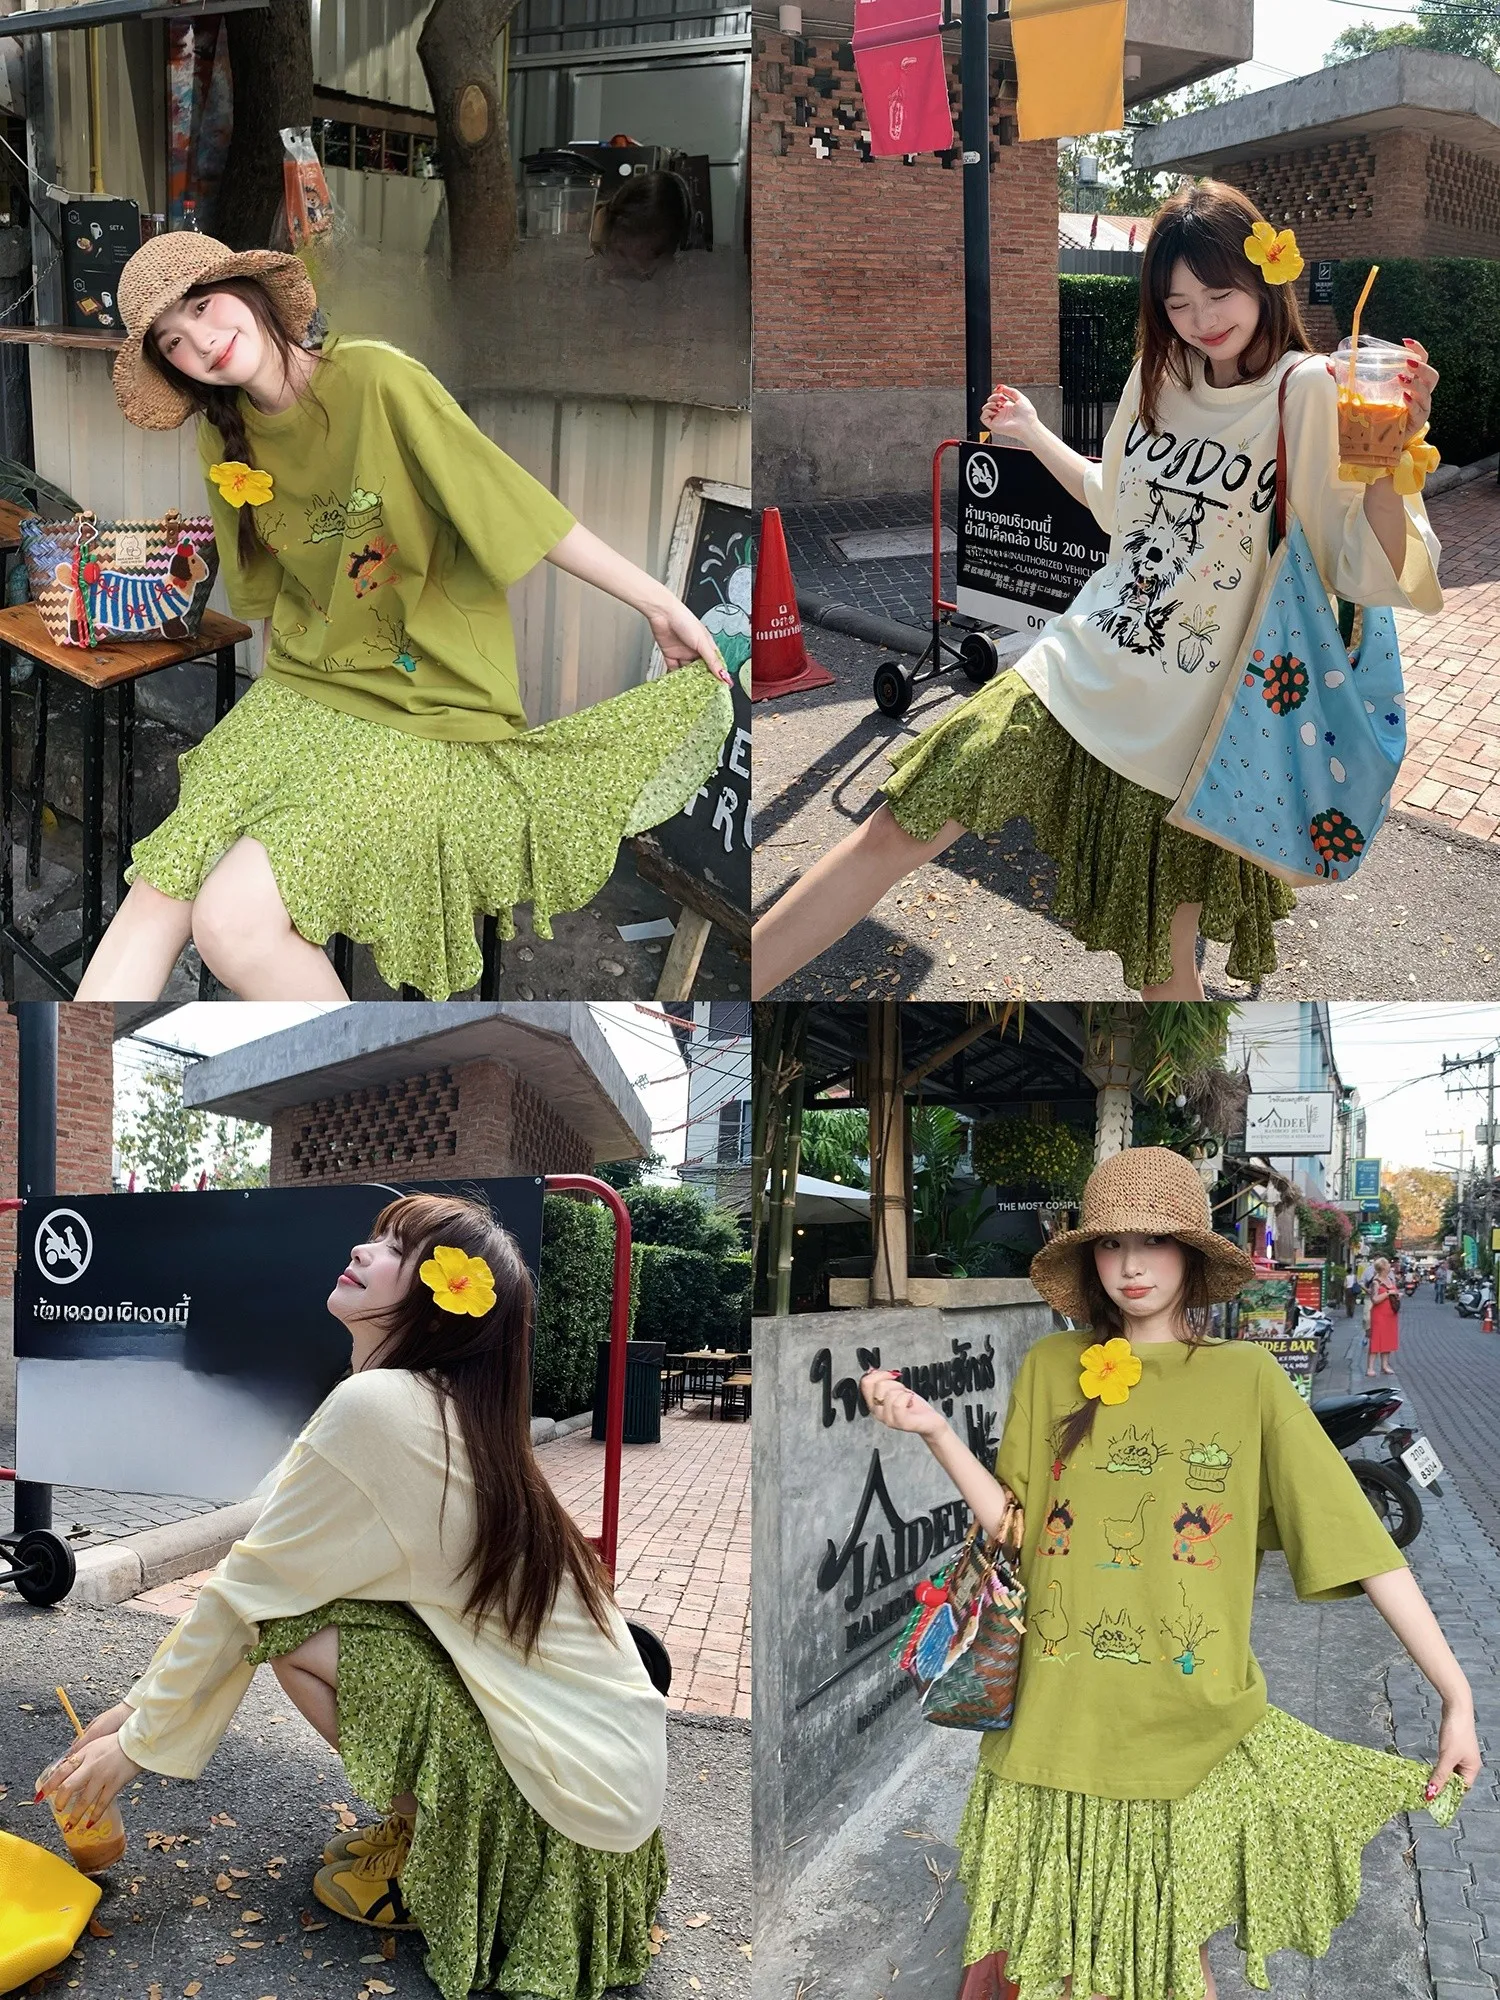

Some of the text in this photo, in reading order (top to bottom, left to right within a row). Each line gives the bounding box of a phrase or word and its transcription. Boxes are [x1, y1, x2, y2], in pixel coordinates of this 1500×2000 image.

[965, 503, 1052, 534] ห้ามจอดบริเวณนี้
[1034, 534, 1058, 553] ปรับ
[1062, 541, 1086, 559] 200
[1264, 1118, 1306, 1128] JAIDEE
[998, 1202, 1016, 1211] THE
[1017, 1202, 1044, 1211] MOST
[1290, 1340, 1317, 1353] BAR
[1420, 1461, 1437, 1480] 8304
[844, 1498, 973, 1613] JAIDEE
